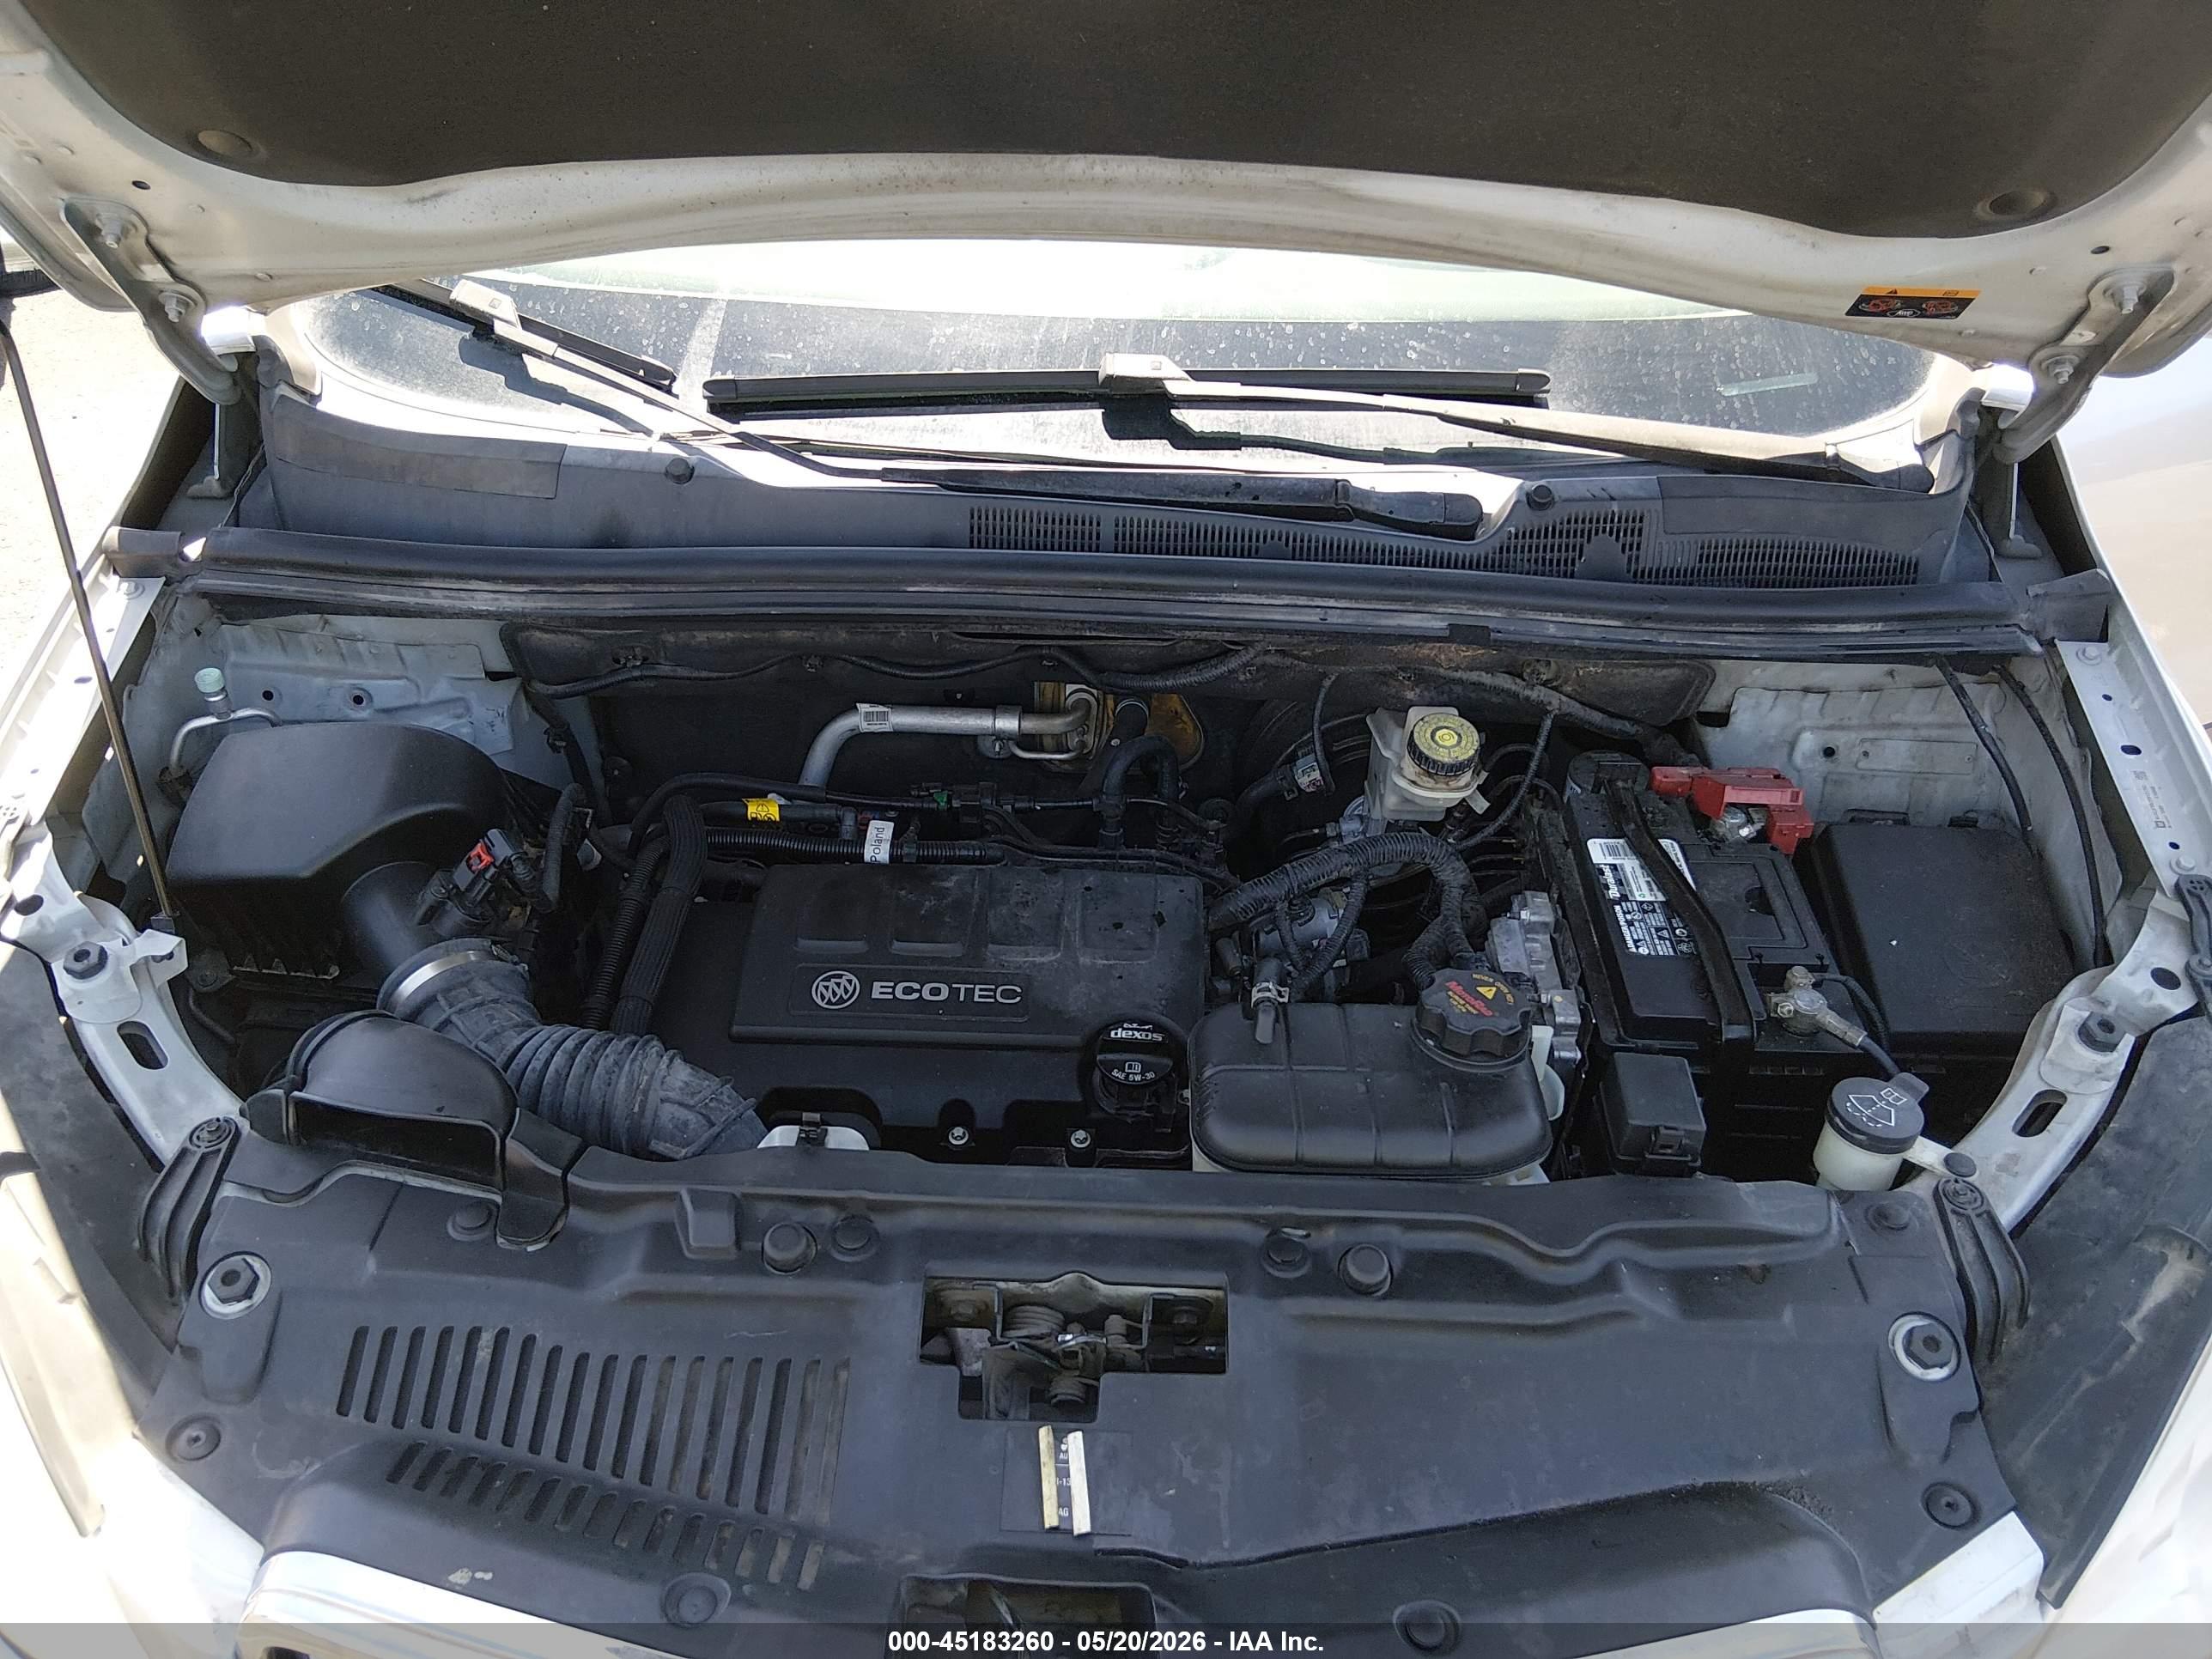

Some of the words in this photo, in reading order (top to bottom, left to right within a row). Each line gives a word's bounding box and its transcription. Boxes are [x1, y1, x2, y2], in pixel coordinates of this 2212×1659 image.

[869, 827, 885, 863] Poland
[1598, 864, 1621, 900] Duralast
[871, 981, 1023, 1004] ECOTEC
[1109, 1027, 1165, 1042] dexos
[1111, 1068, 1127, 1079] SAE
[1128, 1071, 1156, 1081] 5W-30
